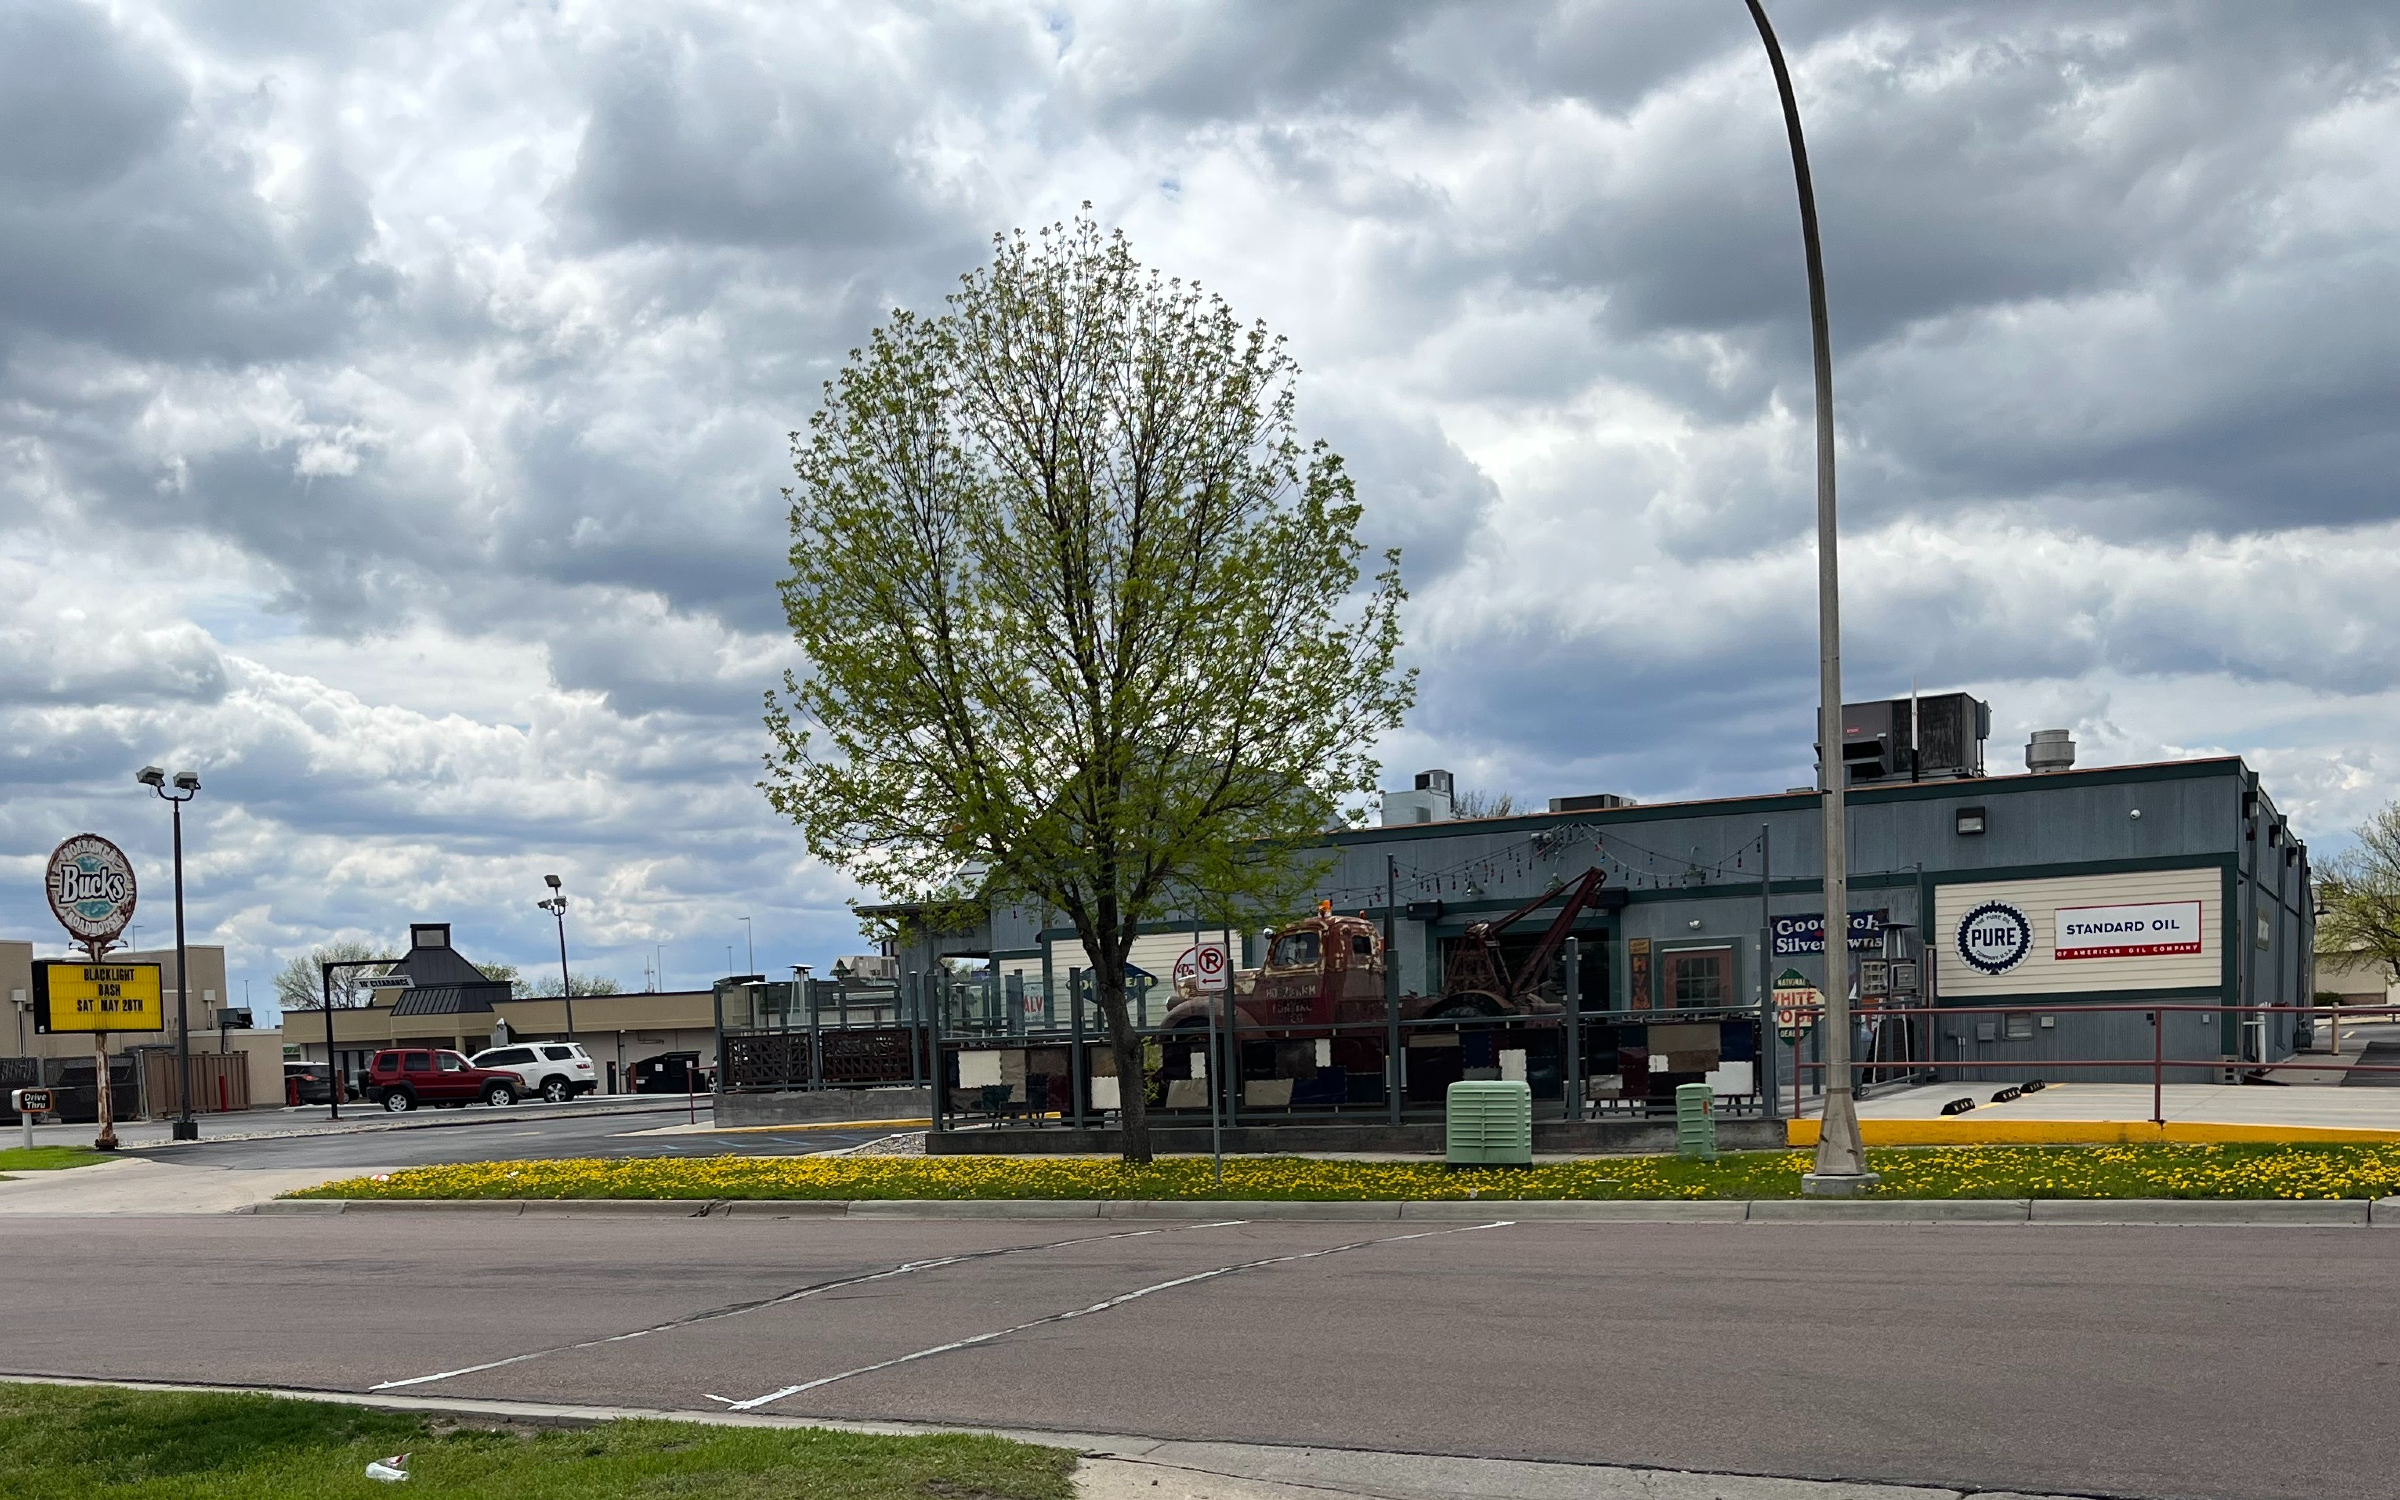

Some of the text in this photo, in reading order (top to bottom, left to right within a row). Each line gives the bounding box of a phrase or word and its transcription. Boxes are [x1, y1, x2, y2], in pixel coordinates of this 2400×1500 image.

[60, 864, 125, 904] Bucks
[2066, 919, 2180, 935] STANDARD OIL
[1971, 927, 2016, 948] PURE
[2128, 946, 2147, 954] OIL
[2153, 944, 2198, 952] COMPANY
[84, 968, 135, 981] BLACKLIGHT
[98, 983, 121, 996] BASH
[370, 979, 409, 987] CLEARANCE
[77, 999, 143, 1012] SAT MAY 28TH
[1780, 1029, 1804, 1037] DEALR
[24, 1093, 47, 1101] Drive
[26, 1101, 46, 1109] Thru
